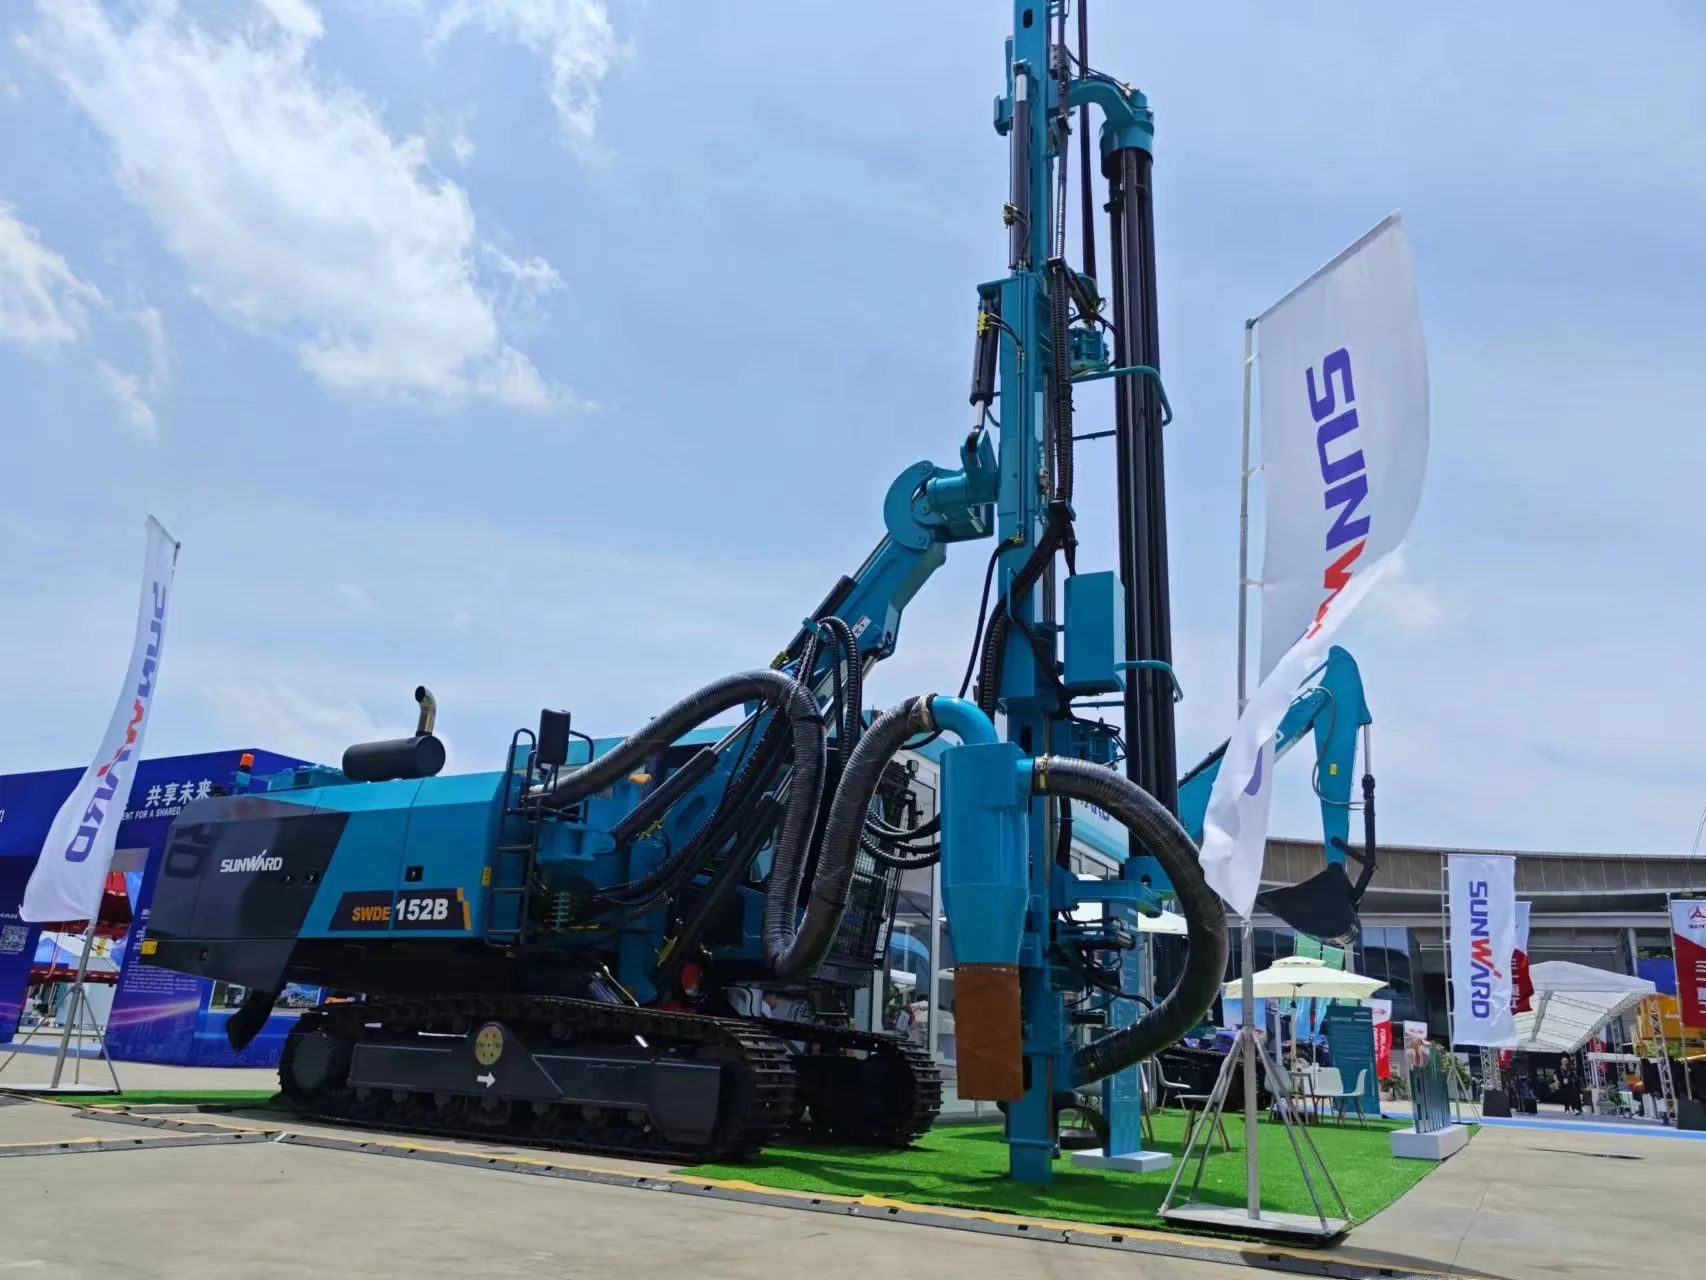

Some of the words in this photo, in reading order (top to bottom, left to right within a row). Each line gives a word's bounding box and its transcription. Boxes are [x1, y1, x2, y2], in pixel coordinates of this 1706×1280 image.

[145, 779, 212, 807] 共享未来
[135, 810, 149, 819] FOR
[156, 807, 181, 817] SHARED
[220, 849, 283, 872] SUNWARD
[352, 906, 391, 921] SWDE
[396, 899, 449, 921] 152B
[1469, 880, 1502, 1019] SUNWARD
